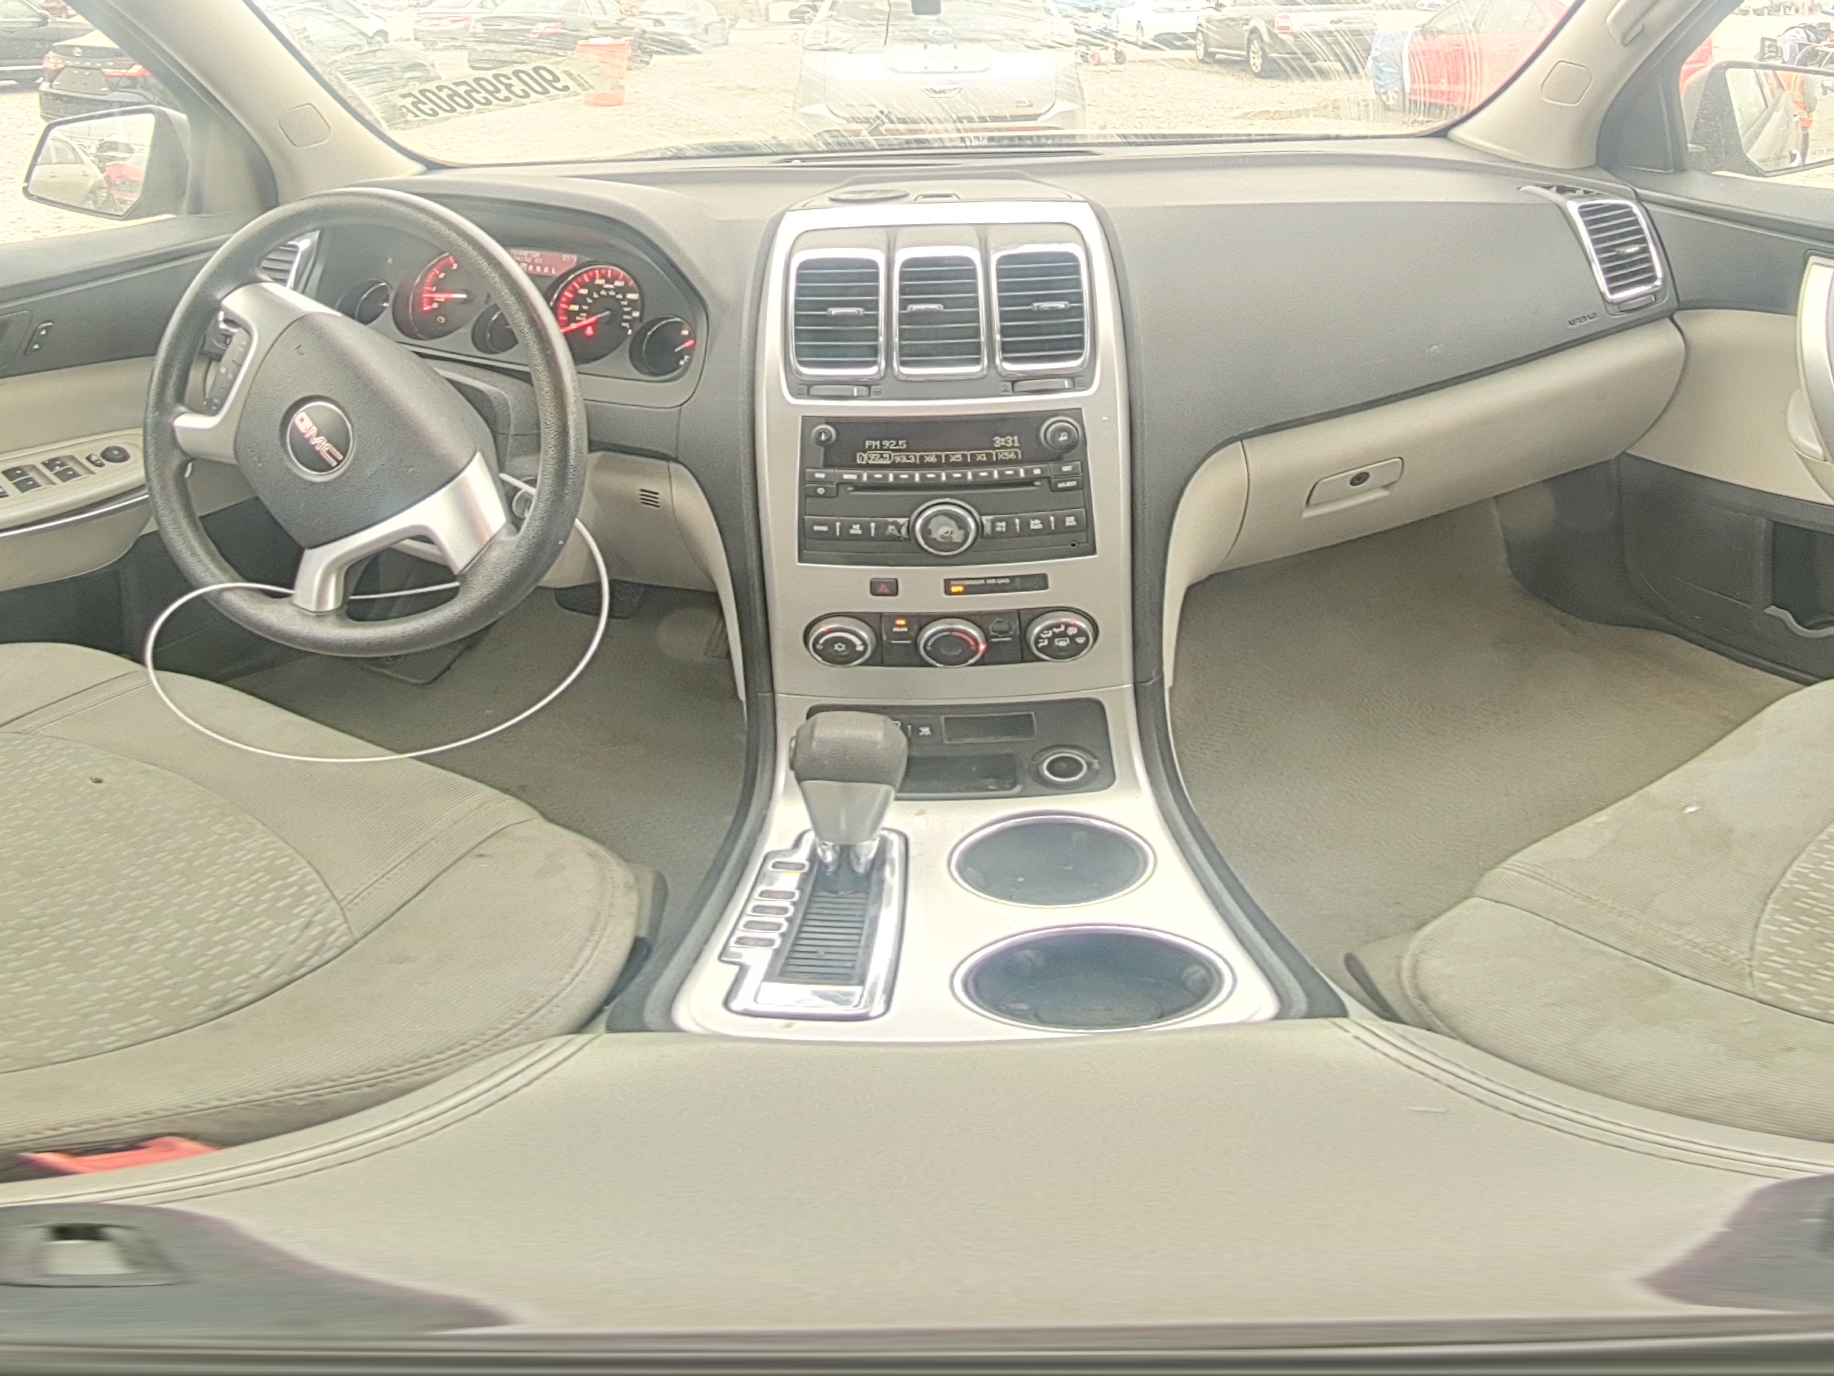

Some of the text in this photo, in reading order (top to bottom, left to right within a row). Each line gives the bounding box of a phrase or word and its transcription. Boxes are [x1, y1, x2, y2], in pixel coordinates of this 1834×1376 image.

[295, 411, 344, 467] GMC
[864, 439, 907, 450] FM 92.5
[992, 435, 1020, 448] 3:31
